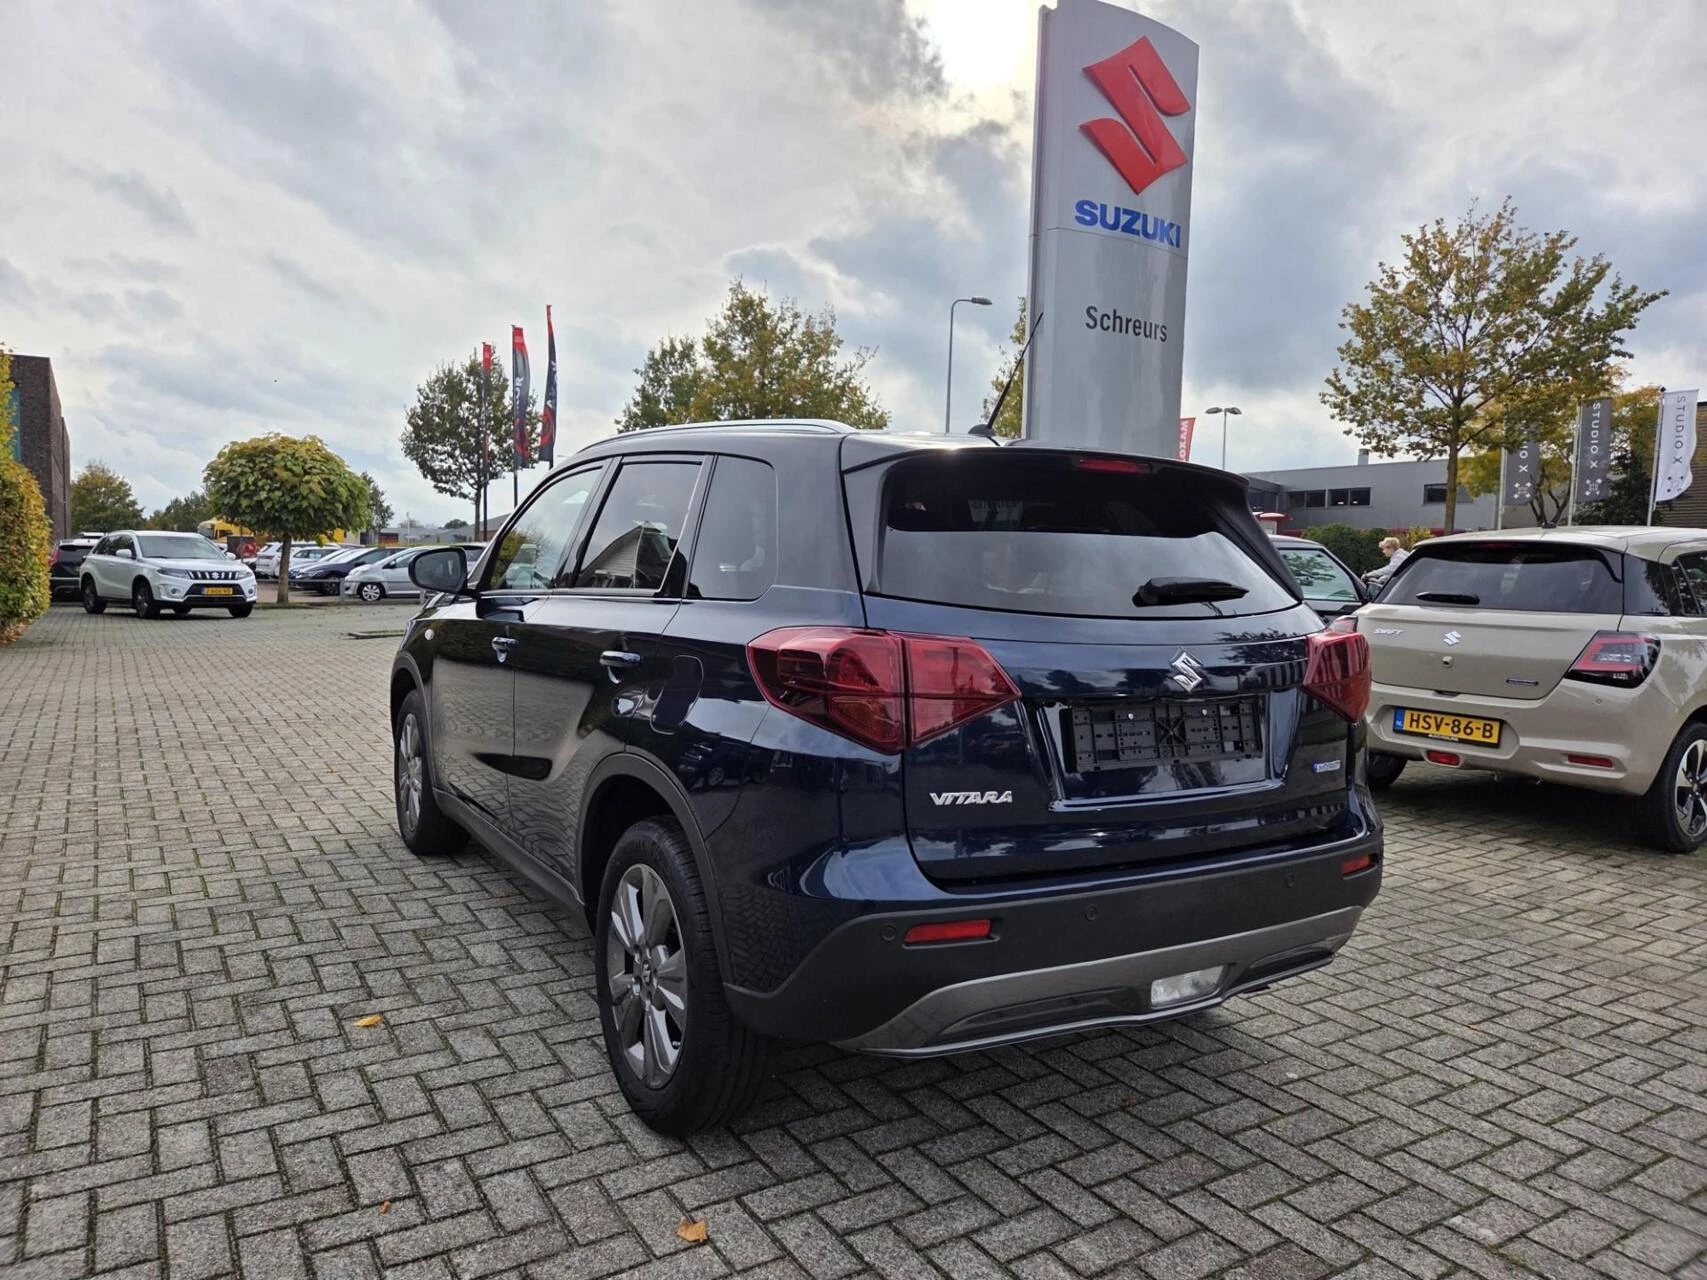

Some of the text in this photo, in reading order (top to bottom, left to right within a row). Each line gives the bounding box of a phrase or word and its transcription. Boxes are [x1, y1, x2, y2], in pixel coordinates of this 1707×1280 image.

[1074, 199, 1181, 249] SUZUKI
[1085, 305, 1168, 342] Schreurs
[1589, 402, 1600, 469] STUDIO X
[1673, 395, 1686, 464] STUDIO X
[1409, 709, 1494, 739] HSV-86-B
[929, 790, 1013, 806] VITARA
